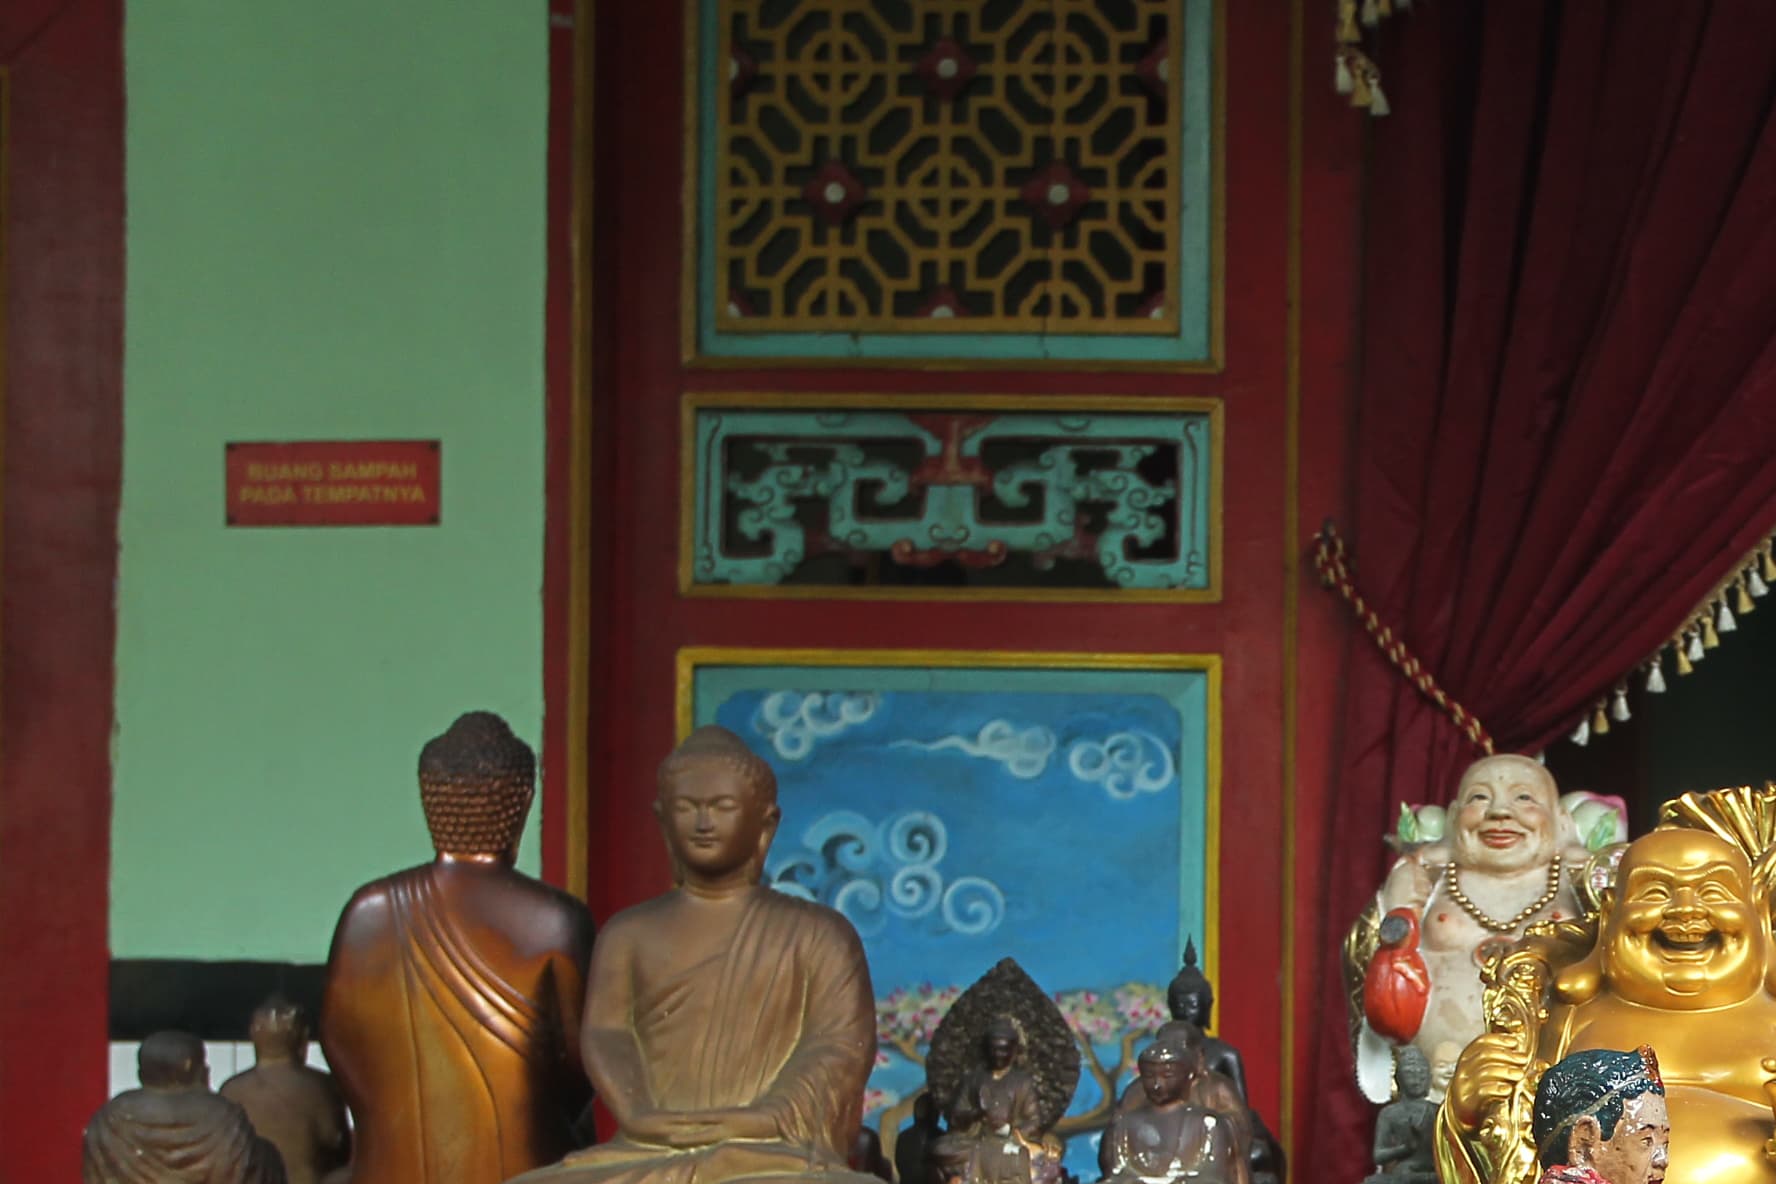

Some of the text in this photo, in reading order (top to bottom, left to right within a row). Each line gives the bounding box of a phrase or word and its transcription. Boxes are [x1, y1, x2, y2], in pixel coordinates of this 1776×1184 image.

[247, 462, 417, 480] BUANG SAMPAH
[239, 485, 426, 504] PADA TEMPATNYA
